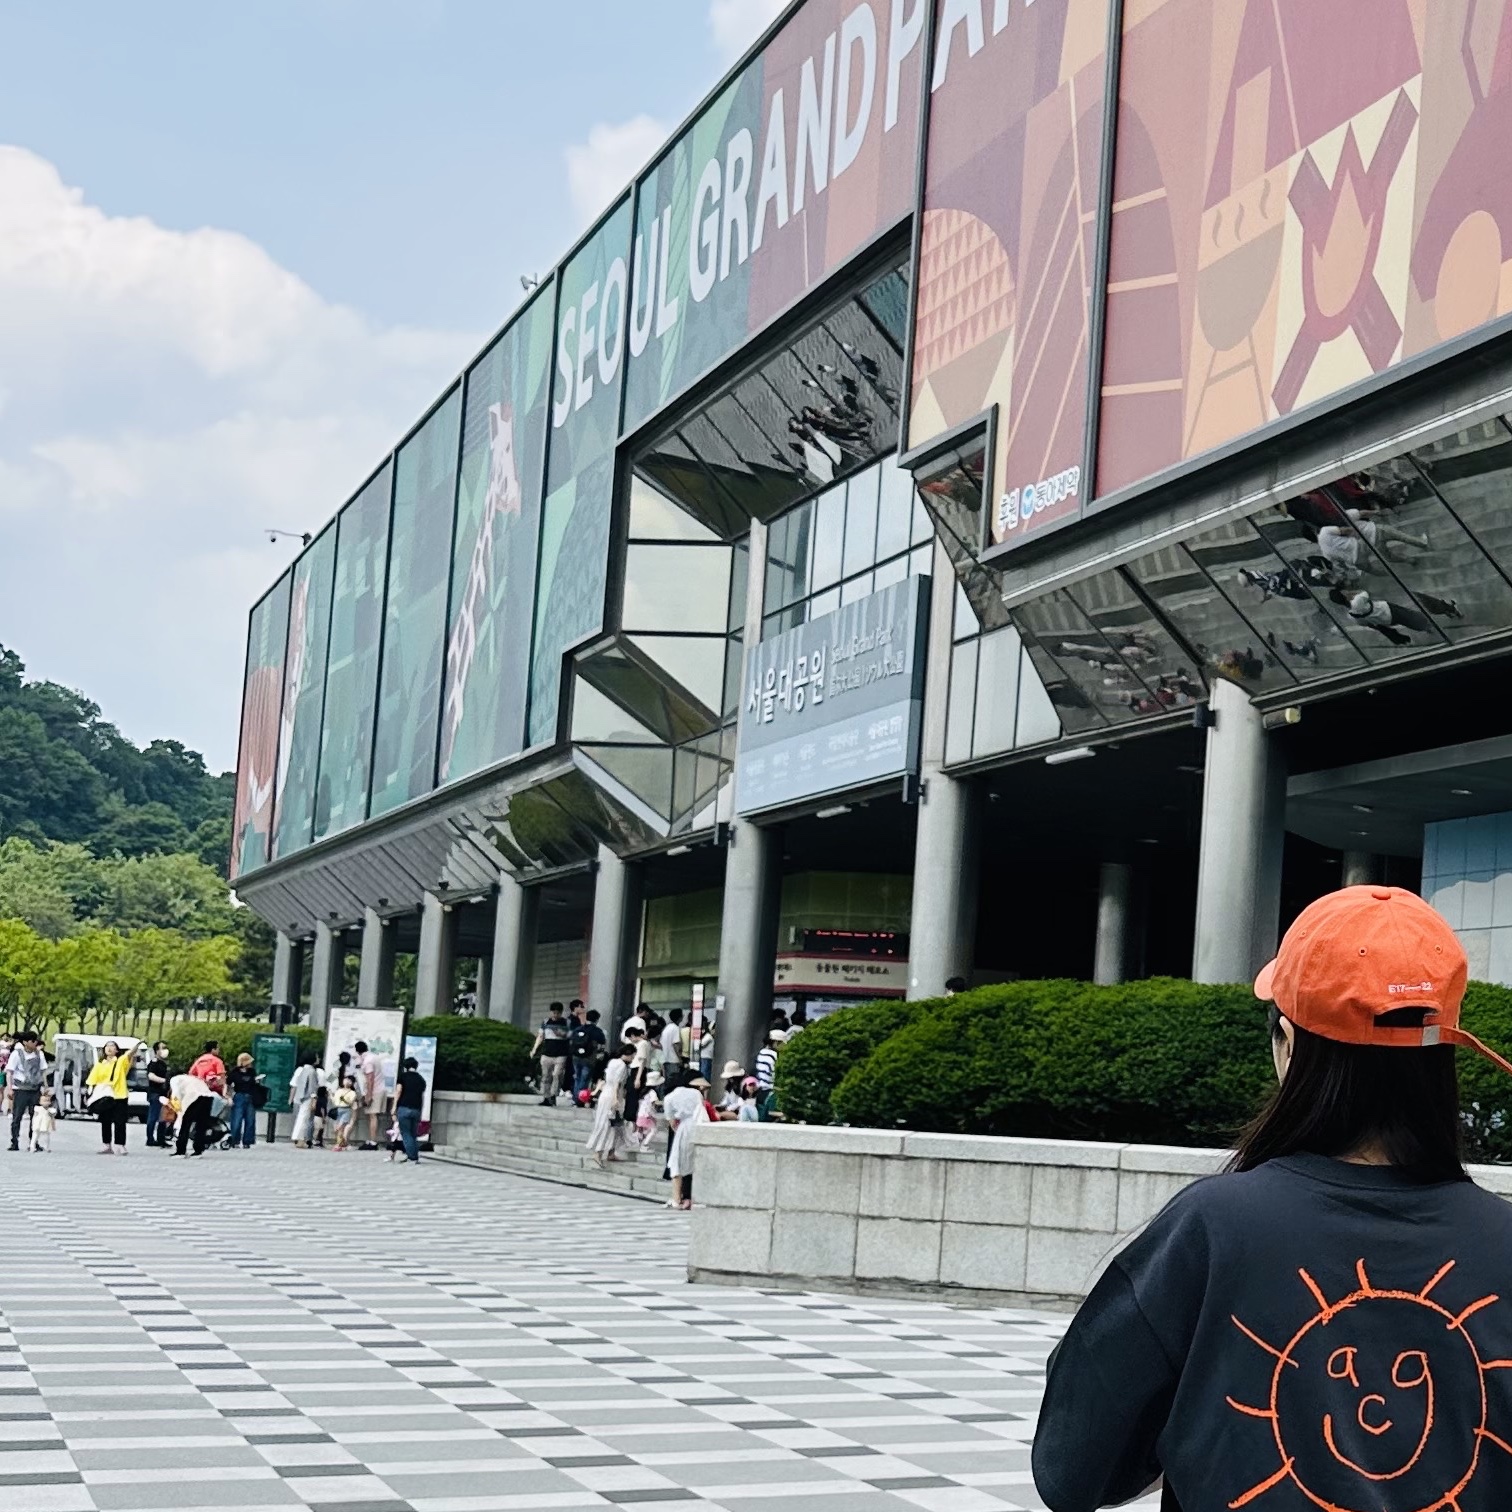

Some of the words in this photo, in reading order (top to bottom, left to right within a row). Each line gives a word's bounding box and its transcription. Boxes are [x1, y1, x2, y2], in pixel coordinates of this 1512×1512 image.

[554, 204, 679, 428] SEOUL
[689, 2, 878, 302] GRAND
[748, 639, 828, 724] 서울대공원
